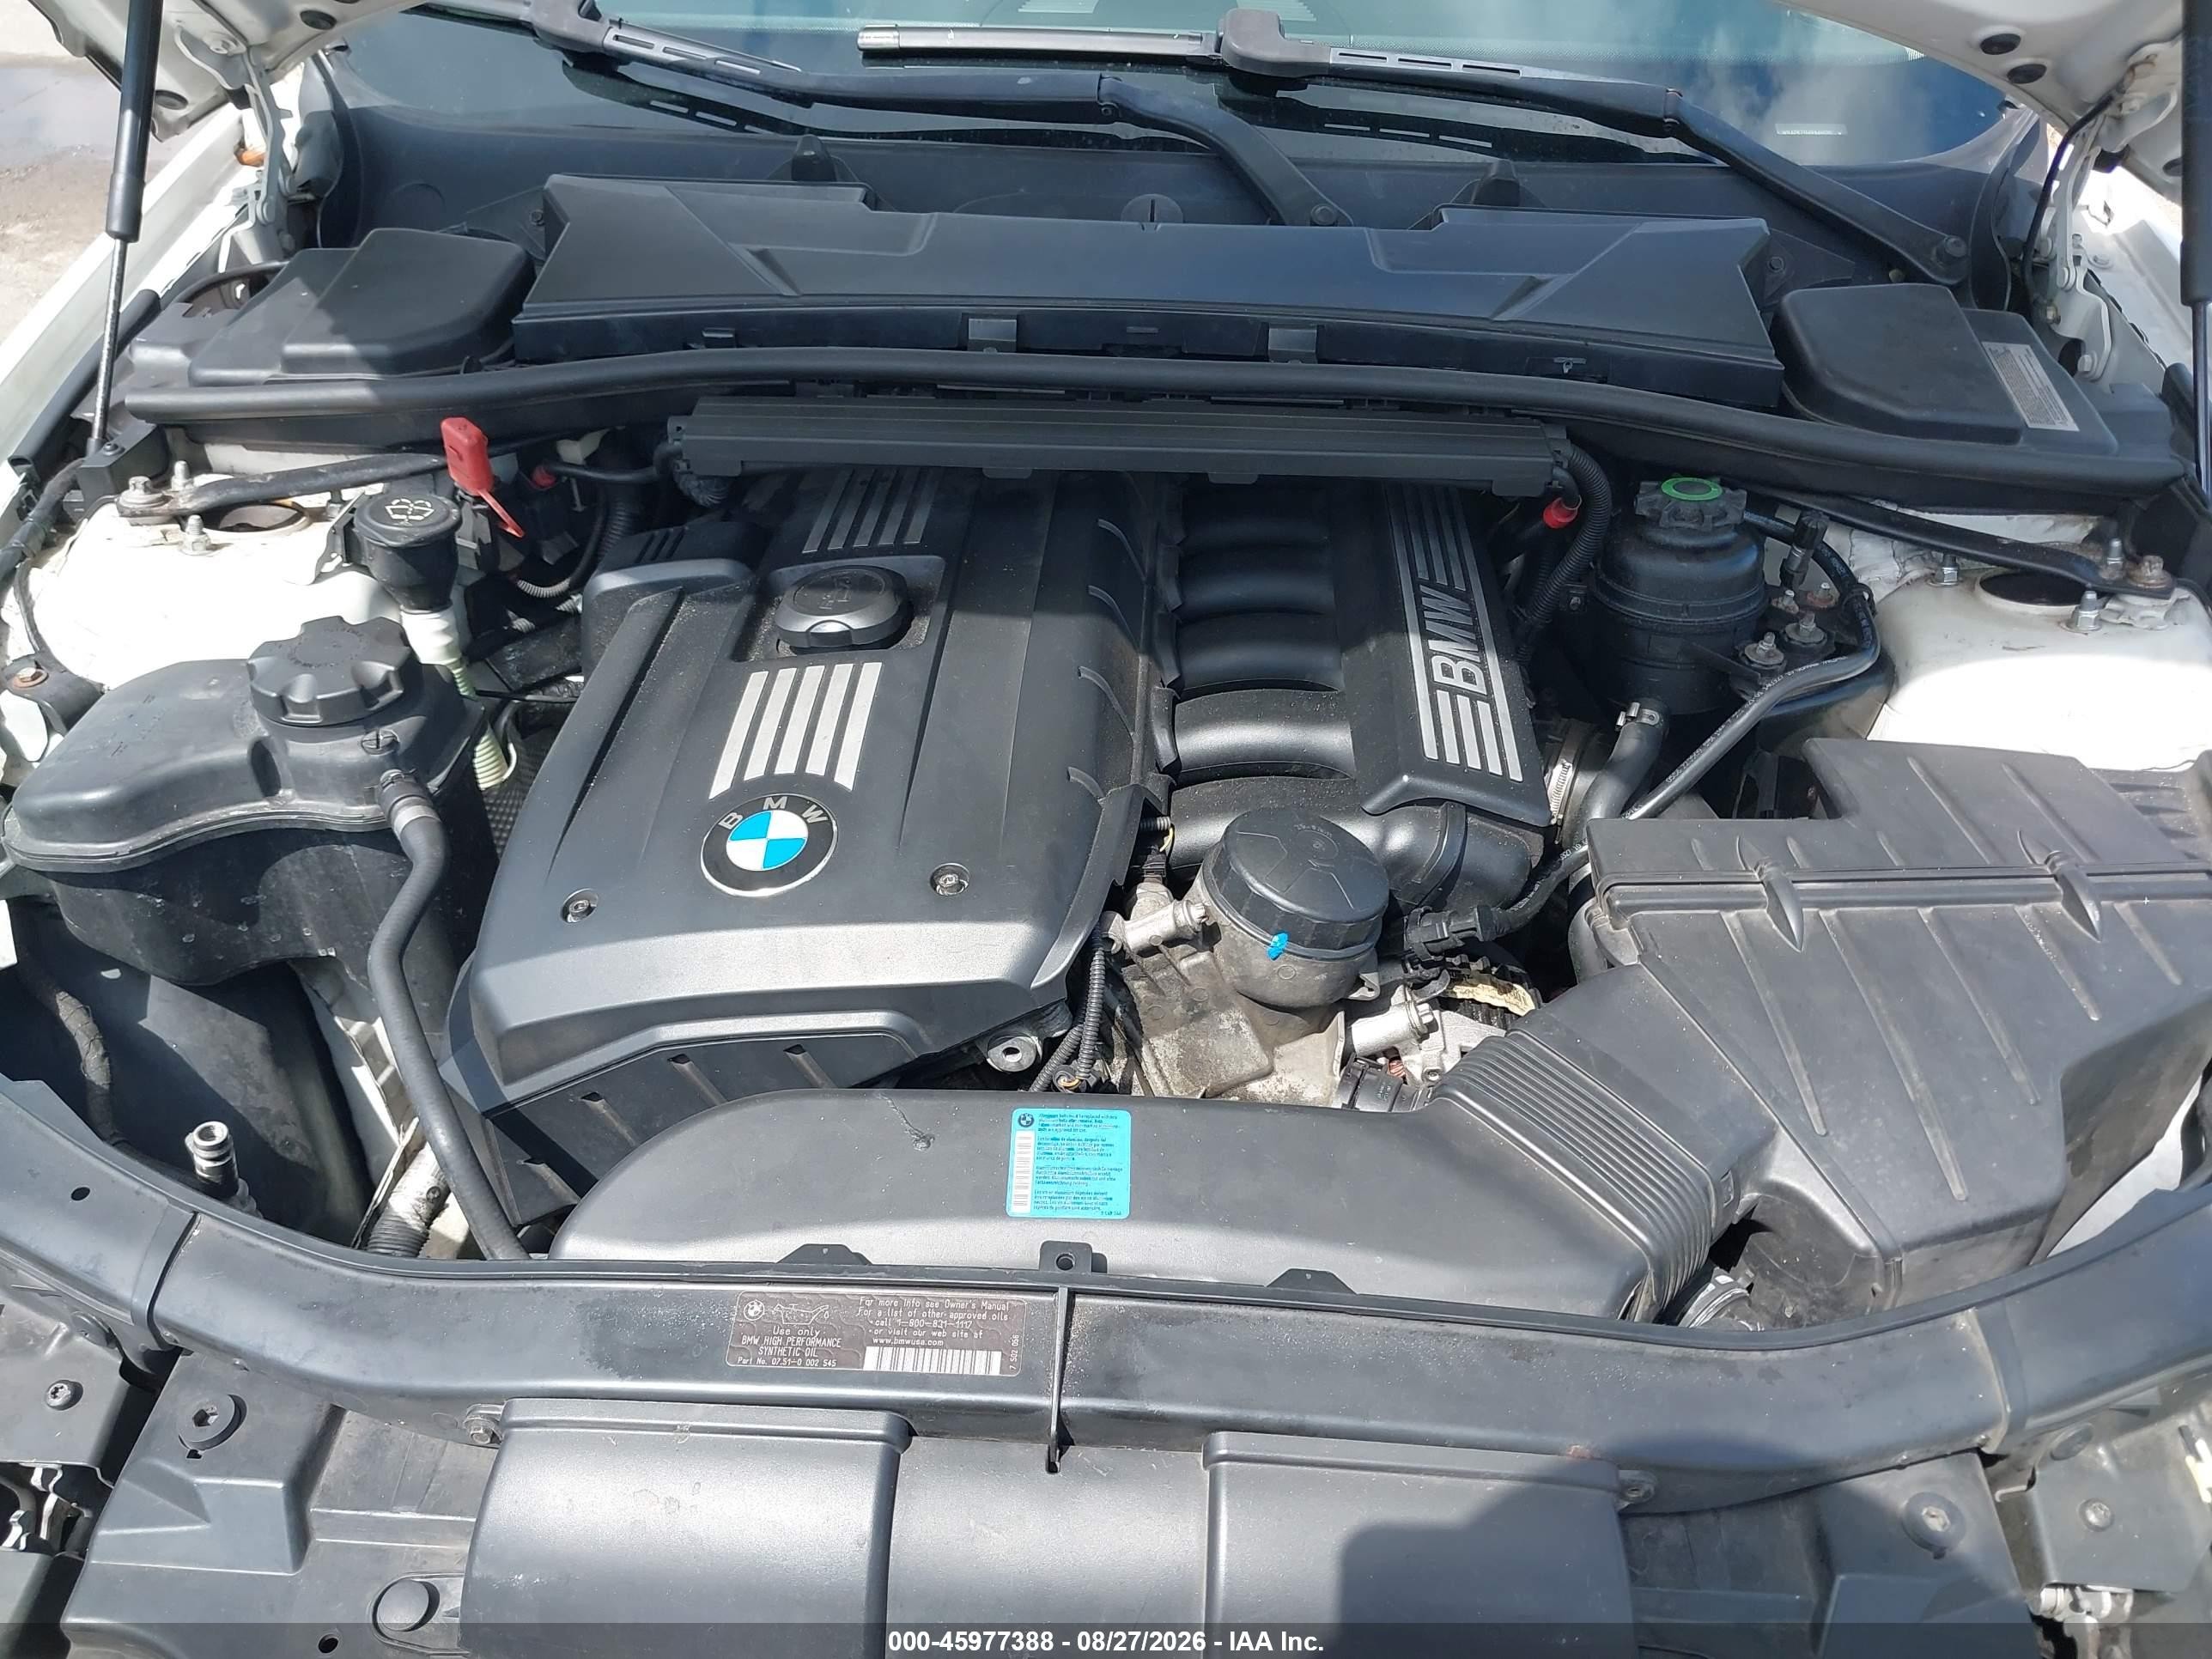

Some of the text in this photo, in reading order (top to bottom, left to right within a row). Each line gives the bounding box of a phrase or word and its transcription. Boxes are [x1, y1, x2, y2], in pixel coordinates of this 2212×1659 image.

[1419, 585, 1487, 695] BMW
[718, 796, 828, 830] BMW
[860, 1296, 873, 1306] For
[945, 1298, 976, 1309] Owner's
[981, 1300, 1009, 1311] Manual
[858, 1306, 872, 1316] For
[887, 1307, 902, 1316] list
[908, 1308, 917, 1316] of
[921, 1308, 944, 1318] other
[949, 1311, 987, 1321] approved
[991, 1311, 1008, 1321] oils
[875, 1317, 891, 1326] call
[773, 1325, 820, 1338] Use only
[951, 1329, 969, 1338] site
[974, 1330, 982, 1339] at
[741, 1335, 842, 1347] BMW HIGH PERFORMANCE
[872, 1337, 944, 1346] www.bmwusa.com
[758, 1346, 818, 1358] SYNTHETIC OIL
[757, 1357, 768, 1365] No.
